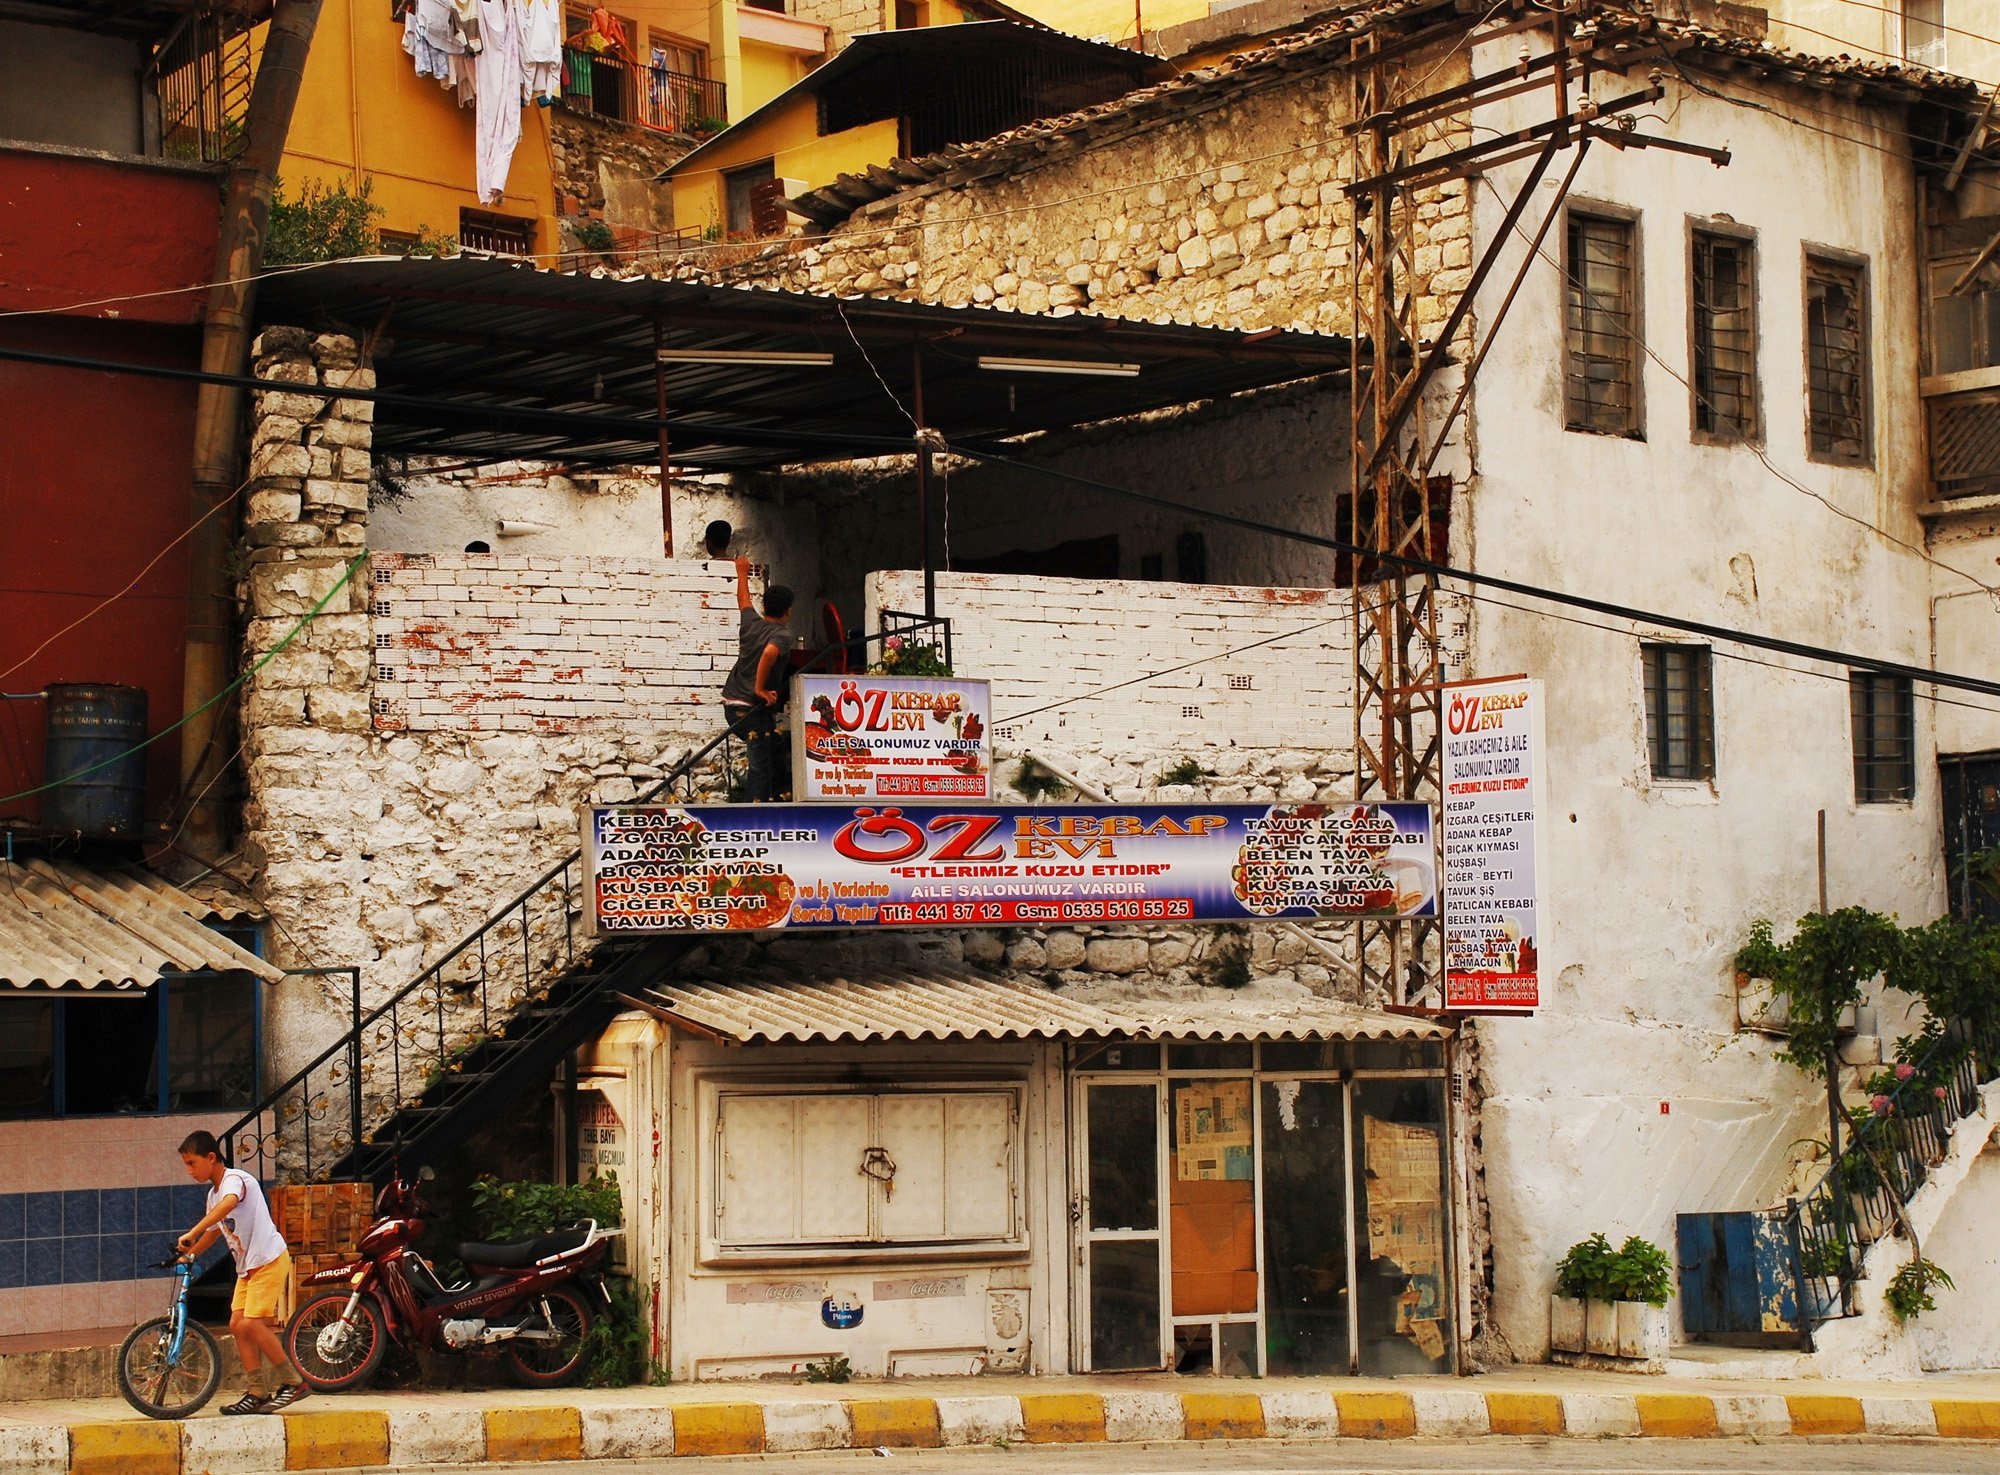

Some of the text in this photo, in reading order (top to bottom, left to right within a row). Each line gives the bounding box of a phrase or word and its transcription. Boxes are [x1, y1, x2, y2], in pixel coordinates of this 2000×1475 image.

[834, 680, 890, 732] ÖZ
[890, 691, 962, 711] KEBAP
[1481, 691, 1528, 713] KEBAP
[1448, 692, 1481, 736] ÖZ
[850, 738, 930, 749] SALONUMUZ
[934, 739, 981, 750] VARDIR
[1448, 741, 1468, 758] YAZLIK
[1505, 736, 1509, 752] &
[893, 758, 924, 766] KUZU
[1454, 758, 1520, 779] SALONUMUZ VARDIR
[1483, 780, 1501, 792] KUZU
[1447, 801, 1475, 812] KEBAP
[600, 816, 680, 828] KEBAP
[1014, 815, 1229, 837] KEBAP
[1244, 818, 1395, 830] TAVUK IZGARA
[1447, 815, 1479, 826] IZGARA
[600, 831, 691, 844] IZGARA
[834, 807, 1006, 863] ÖZ
[1246, 834, 1424, 845] PATLICAN KEBABI
[1447, 827, 1512, 840] ADANA KEBAP
[601, 847, 769, 861] ADANA KEBAP
[1247, 849, 1370, 861] BELEN TAVA
[1447, 842, 1519, 855] BIÇAK KIYMASI
[1447, 857, 1486, 869] KUŞBAŞI
[601, 863, 783, 879] BIÇAK KIYMASI
[1025, 864, 1085, 877] KUZU
[1247, 864, 1371, 876] KIYMA TAVA
[602, 881, 707, 895] KUŞBAŞI
[779, 882, 796, 899] Ev
[799, 886, 814, 898] ve
[832, 881, 889, 898] Yerlerine
[958, 883, 1074, 897] SALONUMUZ
[1078, 882, 1146, 895] VARDIR
[1248, 879, 1395, 892] KUŞBAŞI TAVA
[1447, 886, 1477, 896] TAVUK
[1249, 895, 1364, 907] LAHMACUN
[1447, 899, 1533, 911] PATLICAN KEBABI
[792, 904, 833, 922] Servis
[916, 905, 947, 919] 441
[952, 904, 974, 918] 37
[980, 904, 1001, 917] 12
[1016, 904, 1058, 918] Gsm:
[1063, 903, 1103, 917] 0535
[1109, 902, 1138, 916] 516
[1144, 902, 1163, 915] 55
[1168, 901, 1188, 915] 25
[603, 915, 685, 928] TAVUK
[1447, 914, 1504, 925] BELEN TAVA
[1448, 929, 1505, 939] KIYMA TAVA
[1448, 943, 1517, 955] KUŞBAŞI TAVA
[1448, 957, 1501, 968] LAHMACUN
[832, 1313, 853, 1321] Pilsen
